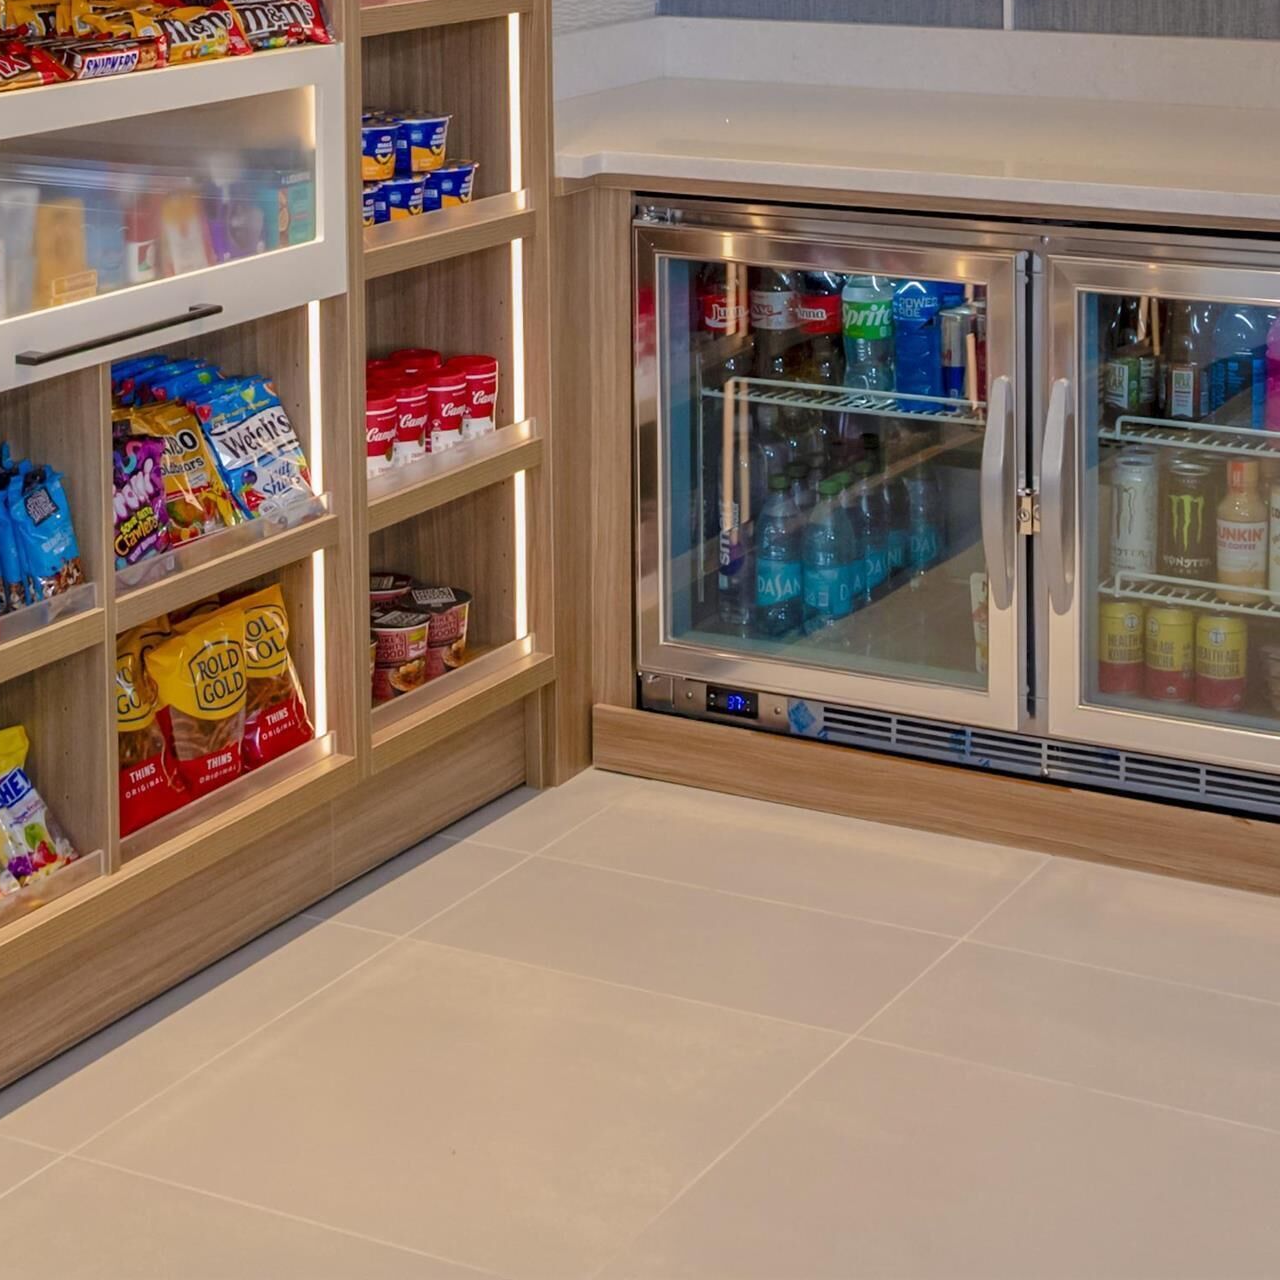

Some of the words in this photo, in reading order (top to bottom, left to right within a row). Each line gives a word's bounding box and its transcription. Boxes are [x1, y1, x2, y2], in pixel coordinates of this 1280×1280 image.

[898, 297, 938, 309] POWER
[842, 303, 893, 328] Sprite
[221, 413, 292, 459] Welch's
[114, 516, 159, 557] Crawlers
[197, 648, 240, 681] ROLD
[203, 671, 244, 703] GOLD
[727, 696, 743, 711] 37
[265, 706, 289, 726] THINS
[262, 720, 296, 741] ORIGINAL
[206, 752, 233, 770] THINS
[129, 762, 156, 784] THINS
[199, 765, 237, 784] ORIGINAL
[125, 776, 164, 799] ORIGINAL
